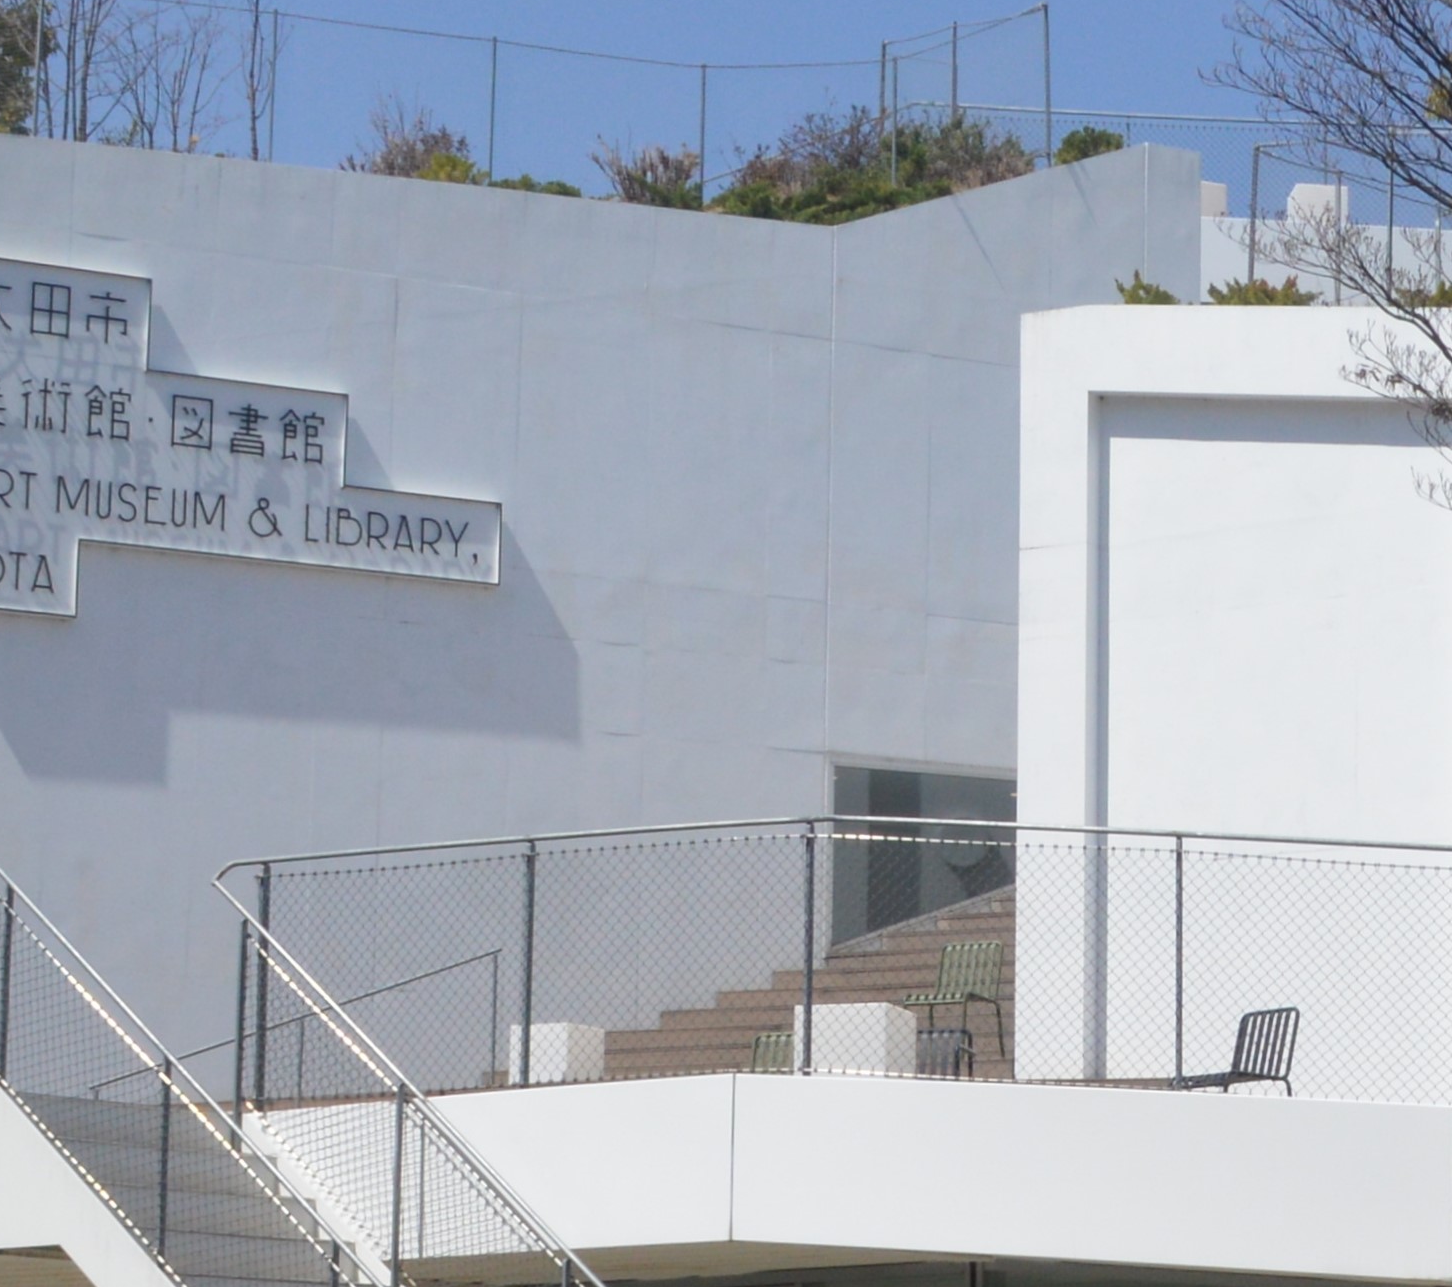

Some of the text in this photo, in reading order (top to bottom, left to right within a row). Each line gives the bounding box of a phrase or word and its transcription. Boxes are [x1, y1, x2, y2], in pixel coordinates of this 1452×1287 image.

[55, 475, 227, 531] MUSEUM
[248, 497, 284, 538] &
[303, 503, 479, 565] LIBRARY,
